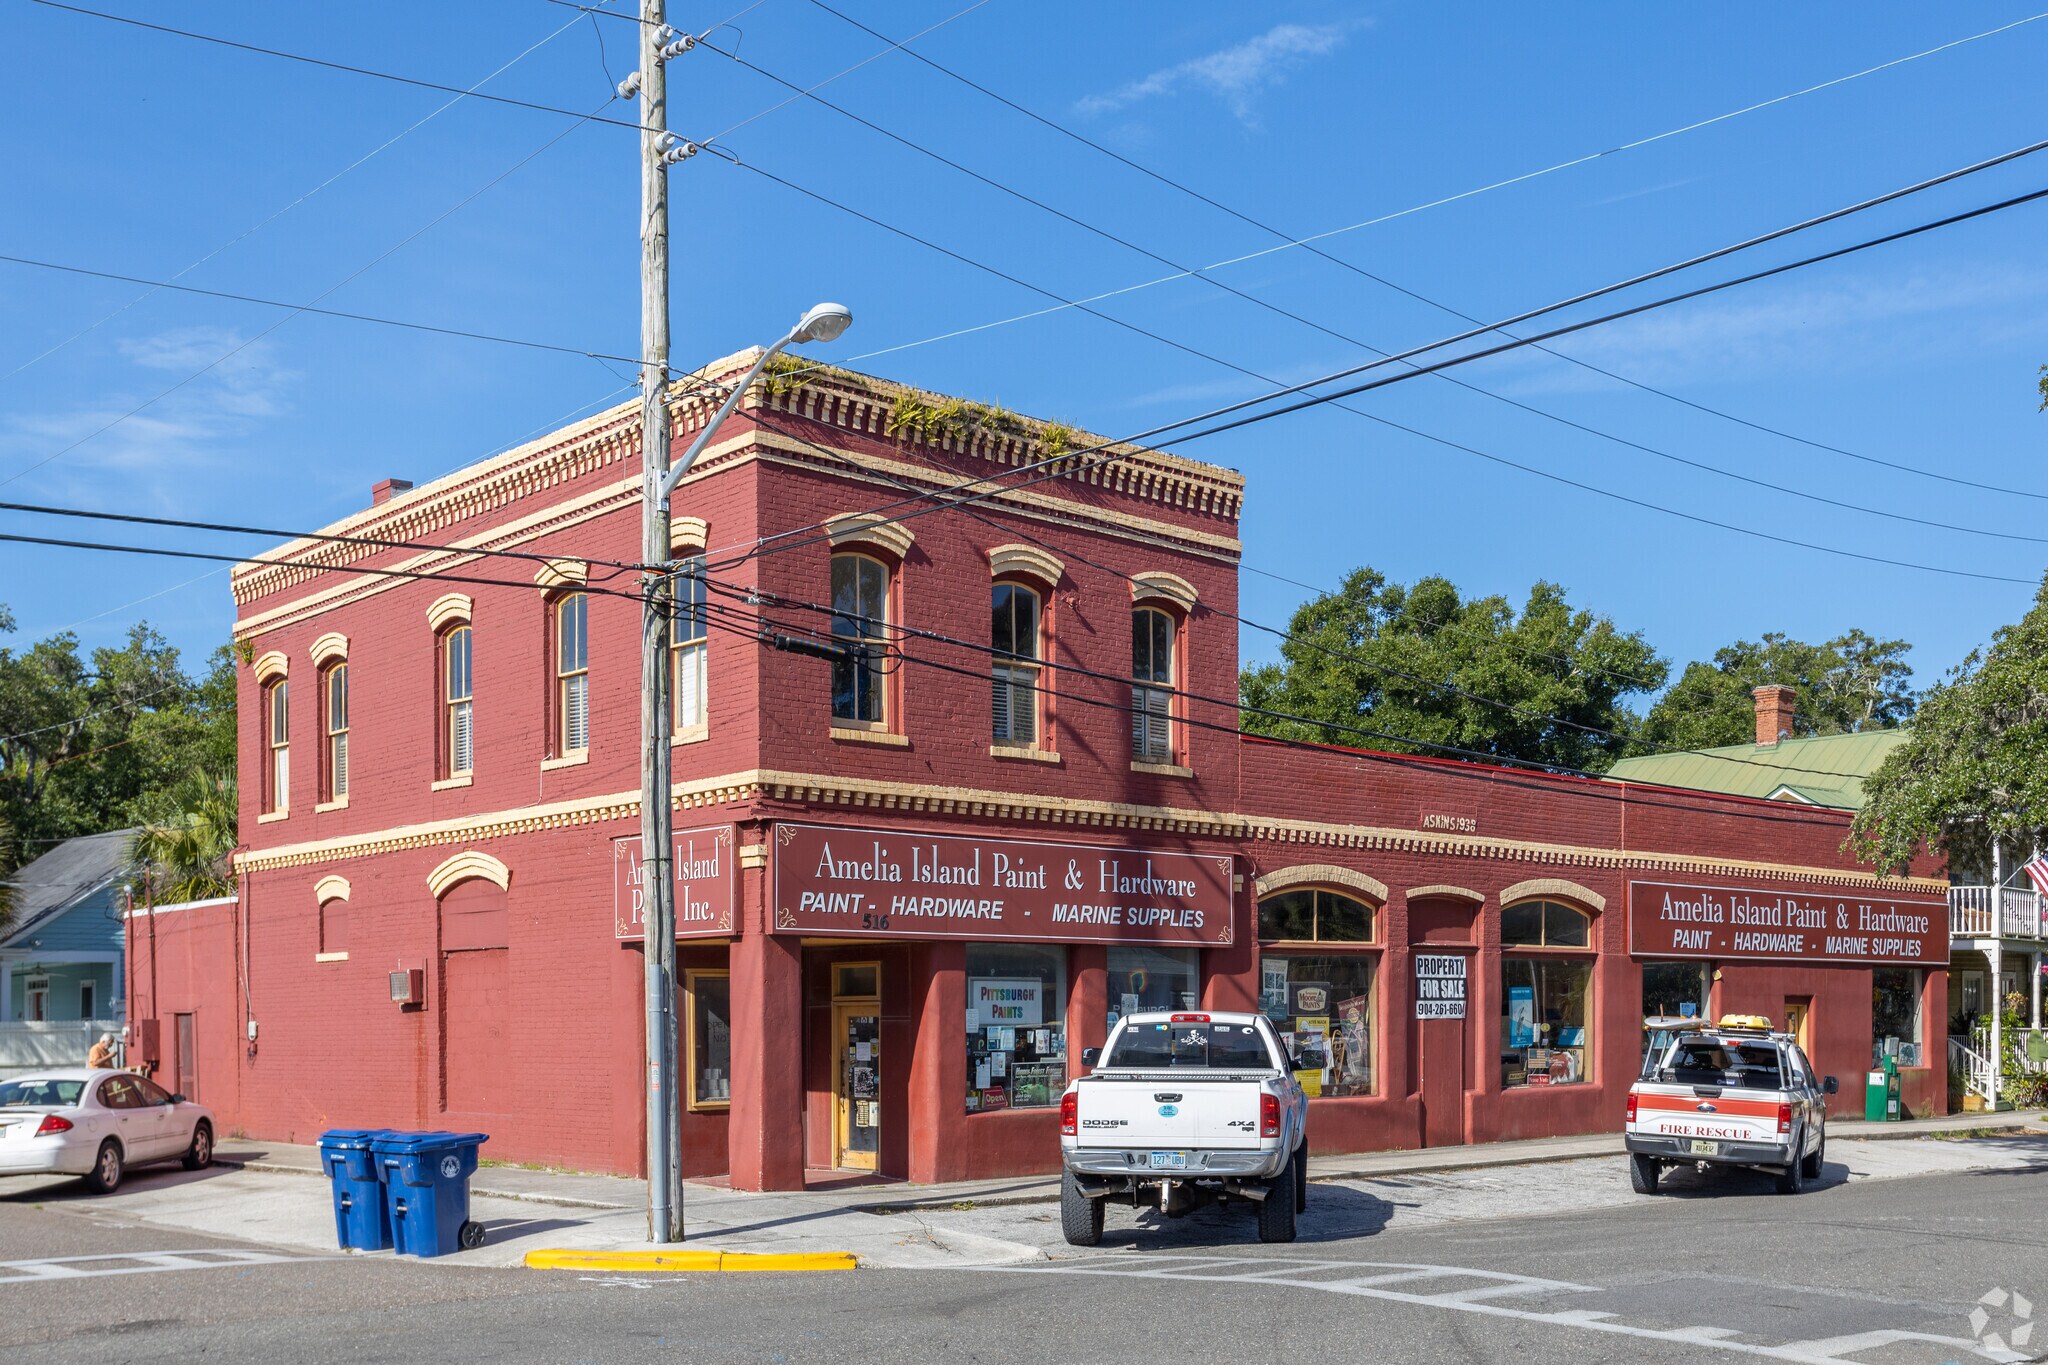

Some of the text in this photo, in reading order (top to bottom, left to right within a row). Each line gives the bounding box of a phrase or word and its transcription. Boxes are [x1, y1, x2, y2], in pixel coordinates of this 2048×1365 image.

[677, 837, 720, 880] Island
[815, 841, 1196, 898] Amelia Island Paint & Hardware
[684, 885, 715, 921] Inc.
[799, 891, 864, 913] PAINT
[891, 896, 1004, 920] HARDWARE
[1052, 903, 1122, 925] MARINE
[1127, 907, 1204, 928] SUPPLIES
[862, 913, 889, 929] 516
[1660, 891, 1929, 934] Amelia Island Paint & Hardware
[1673, 929, 1712, 949] PAINT
[1733, 932, 1804, 952] HARDWARE
[1825, 936, 1868, 955] MARINE
[1871, 937, 1921, 957] SUPPLIES
[1417, 957, 1465, 975] PROPERTY
[981, 986, 1034, 1000] PITTSBURGH
[1420, 979, 1465, 998] FOR SALE
[1299, 993, 1317, 1002] Moore
[1303, 1001, 1320, 1009] PAINTS
[992, 1004, 1023, 1018] PAINTS
[985, 1094, 1004, 1103] Open
[1660, 1124, 1752, 1140] FIRE RESCUE
[1153, 1155, 1165, 1165] 127
